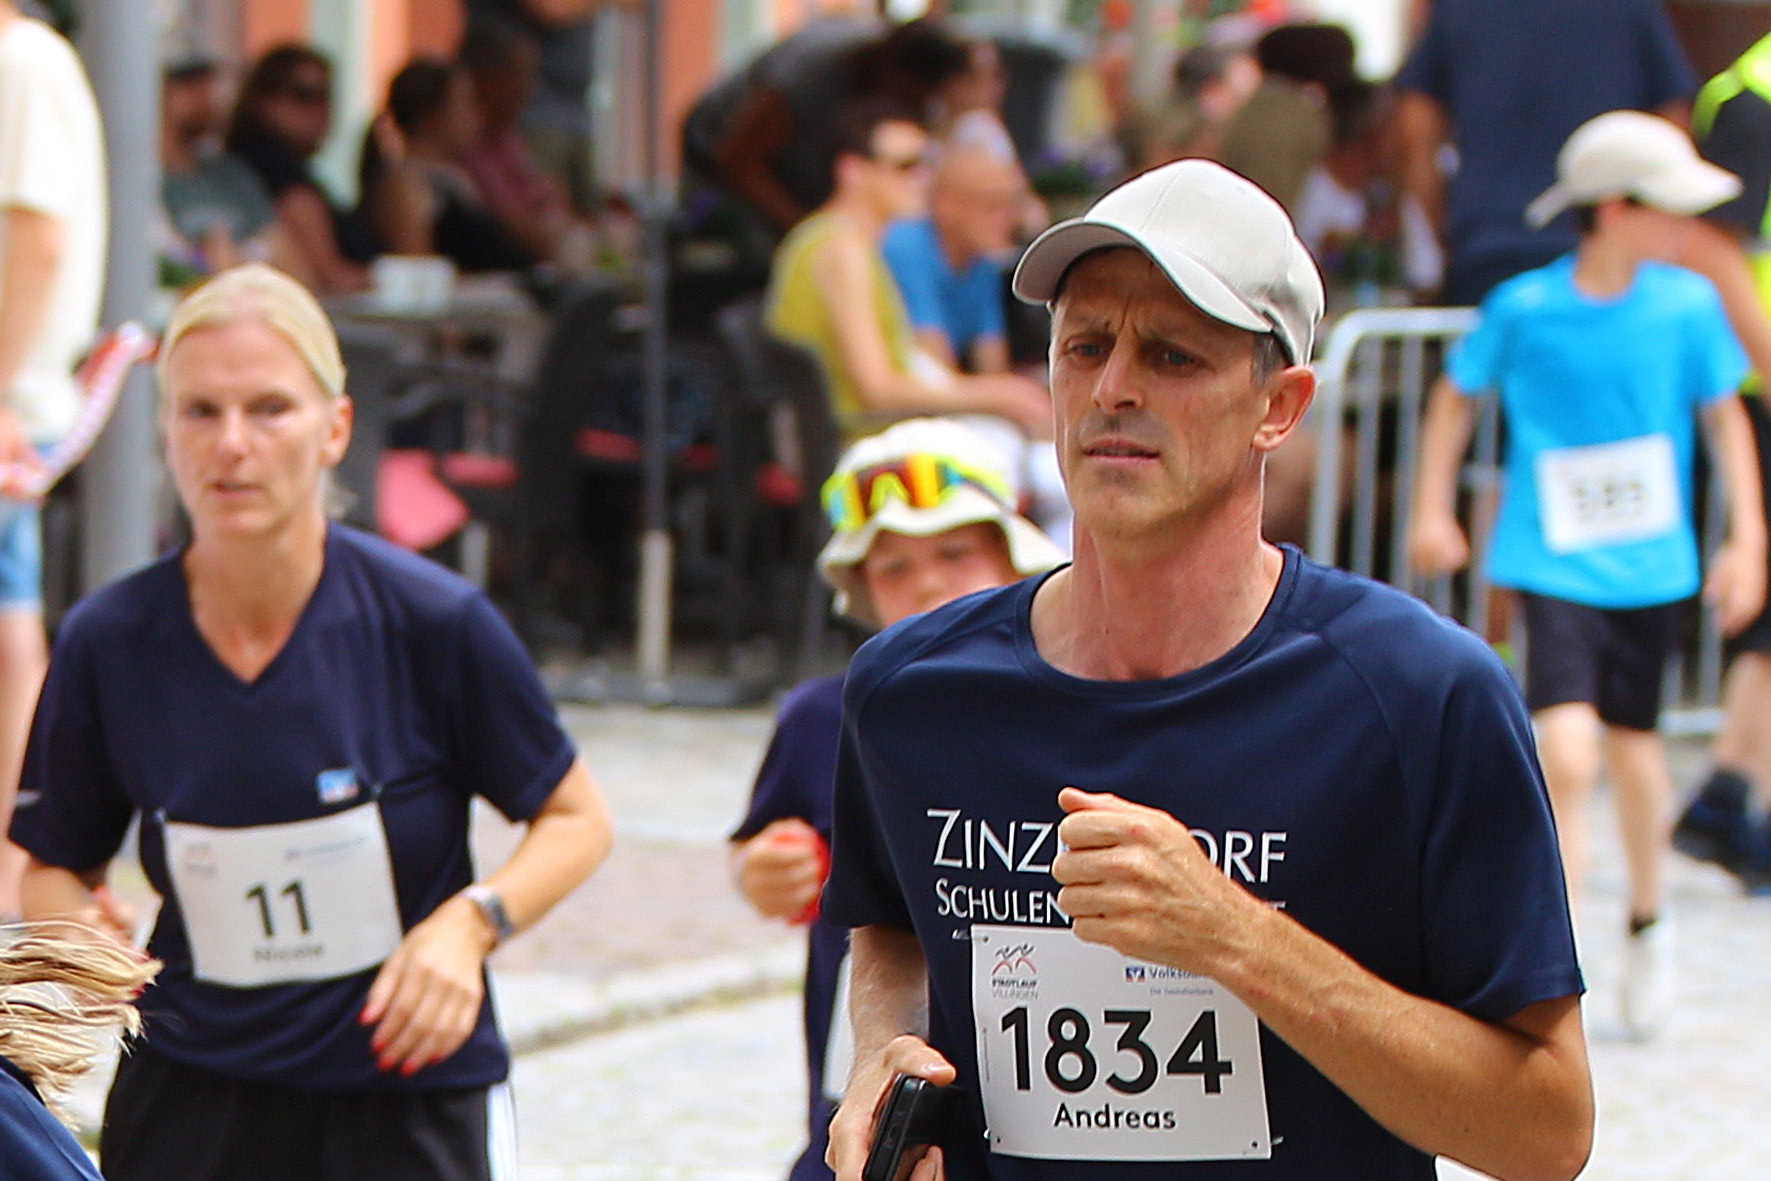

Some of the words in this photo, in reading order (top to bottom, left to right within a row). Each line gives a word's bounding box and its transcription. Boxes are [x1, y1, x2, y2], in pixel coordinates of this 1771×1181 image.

[246, 879, 311, 938] 11
[935, 877, 1070, 925] SCHULEN
[1001, 1006, 1233, 1094] 1834
[1053, 1102, 1176, 1129] Andreas
